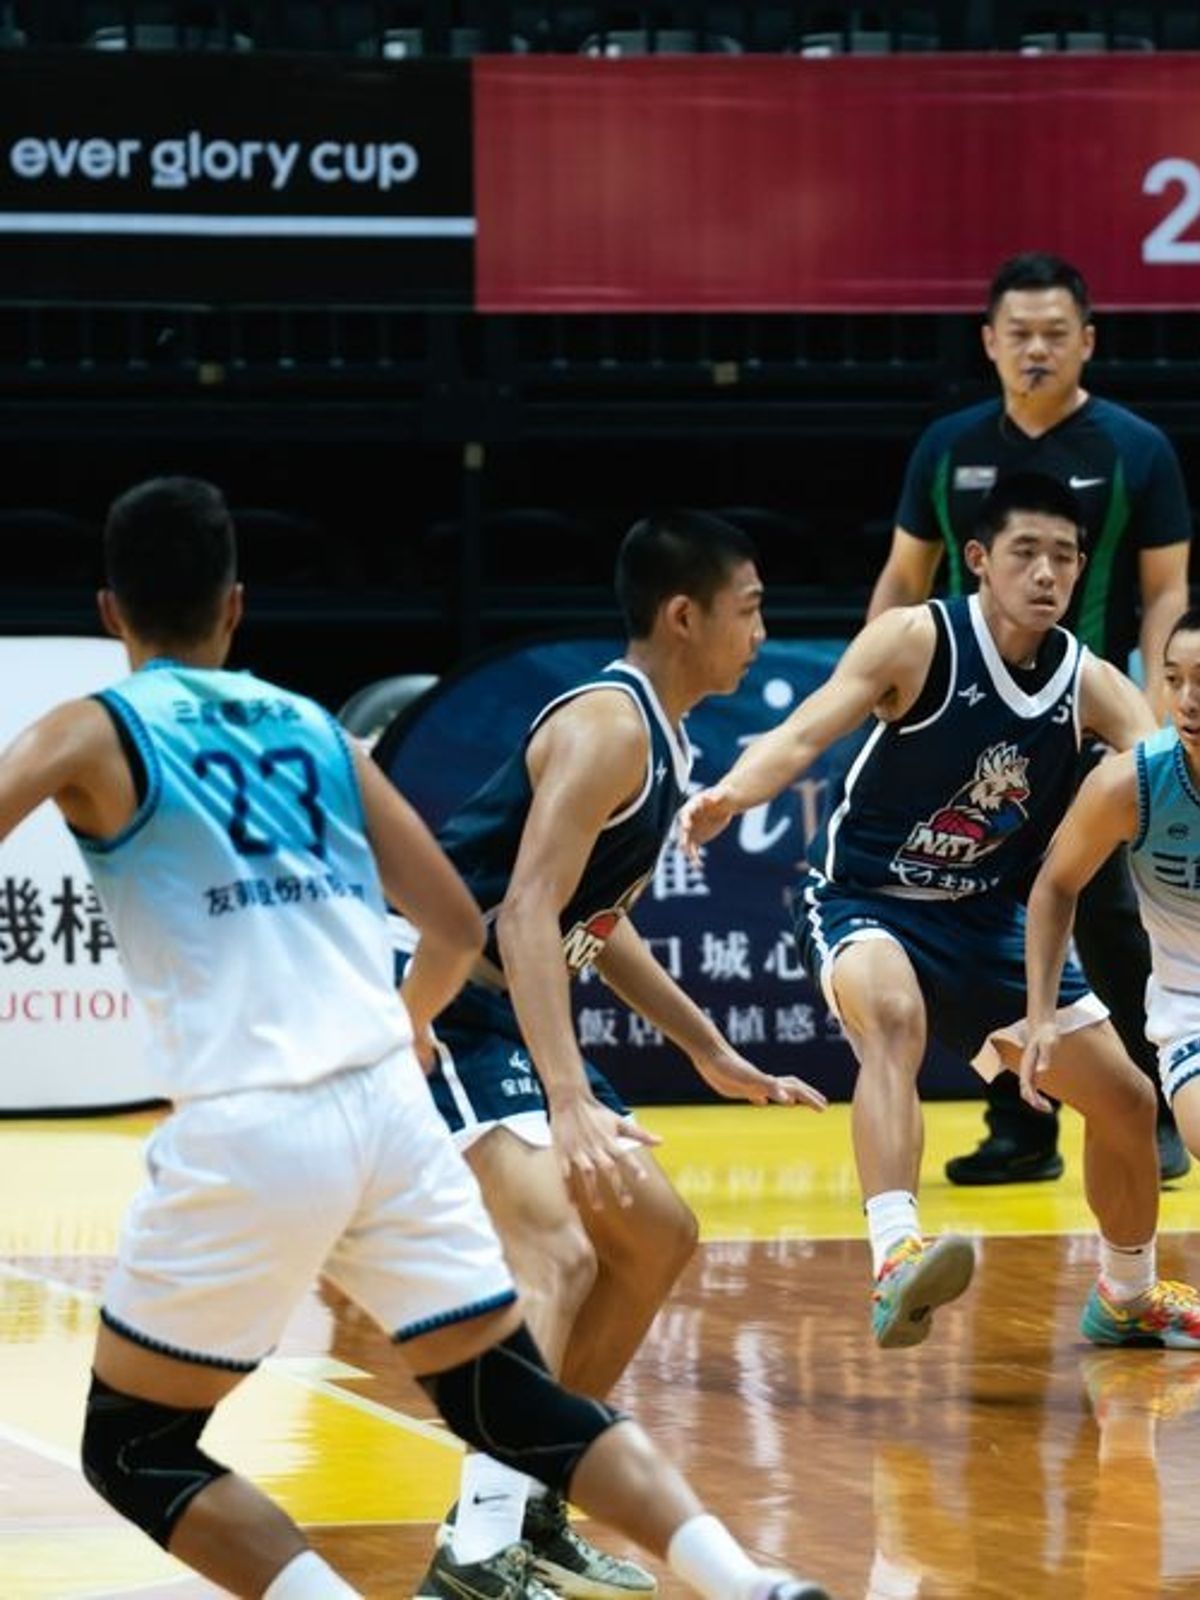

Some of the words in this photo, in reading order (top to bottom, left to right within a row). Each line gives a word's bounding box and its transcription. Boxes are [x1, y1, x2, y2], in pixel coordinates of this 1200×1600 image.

[10, 137, 141, 178] ever
[150, 130, 300, 190] glory
[308, 141, 419, 191] cup
